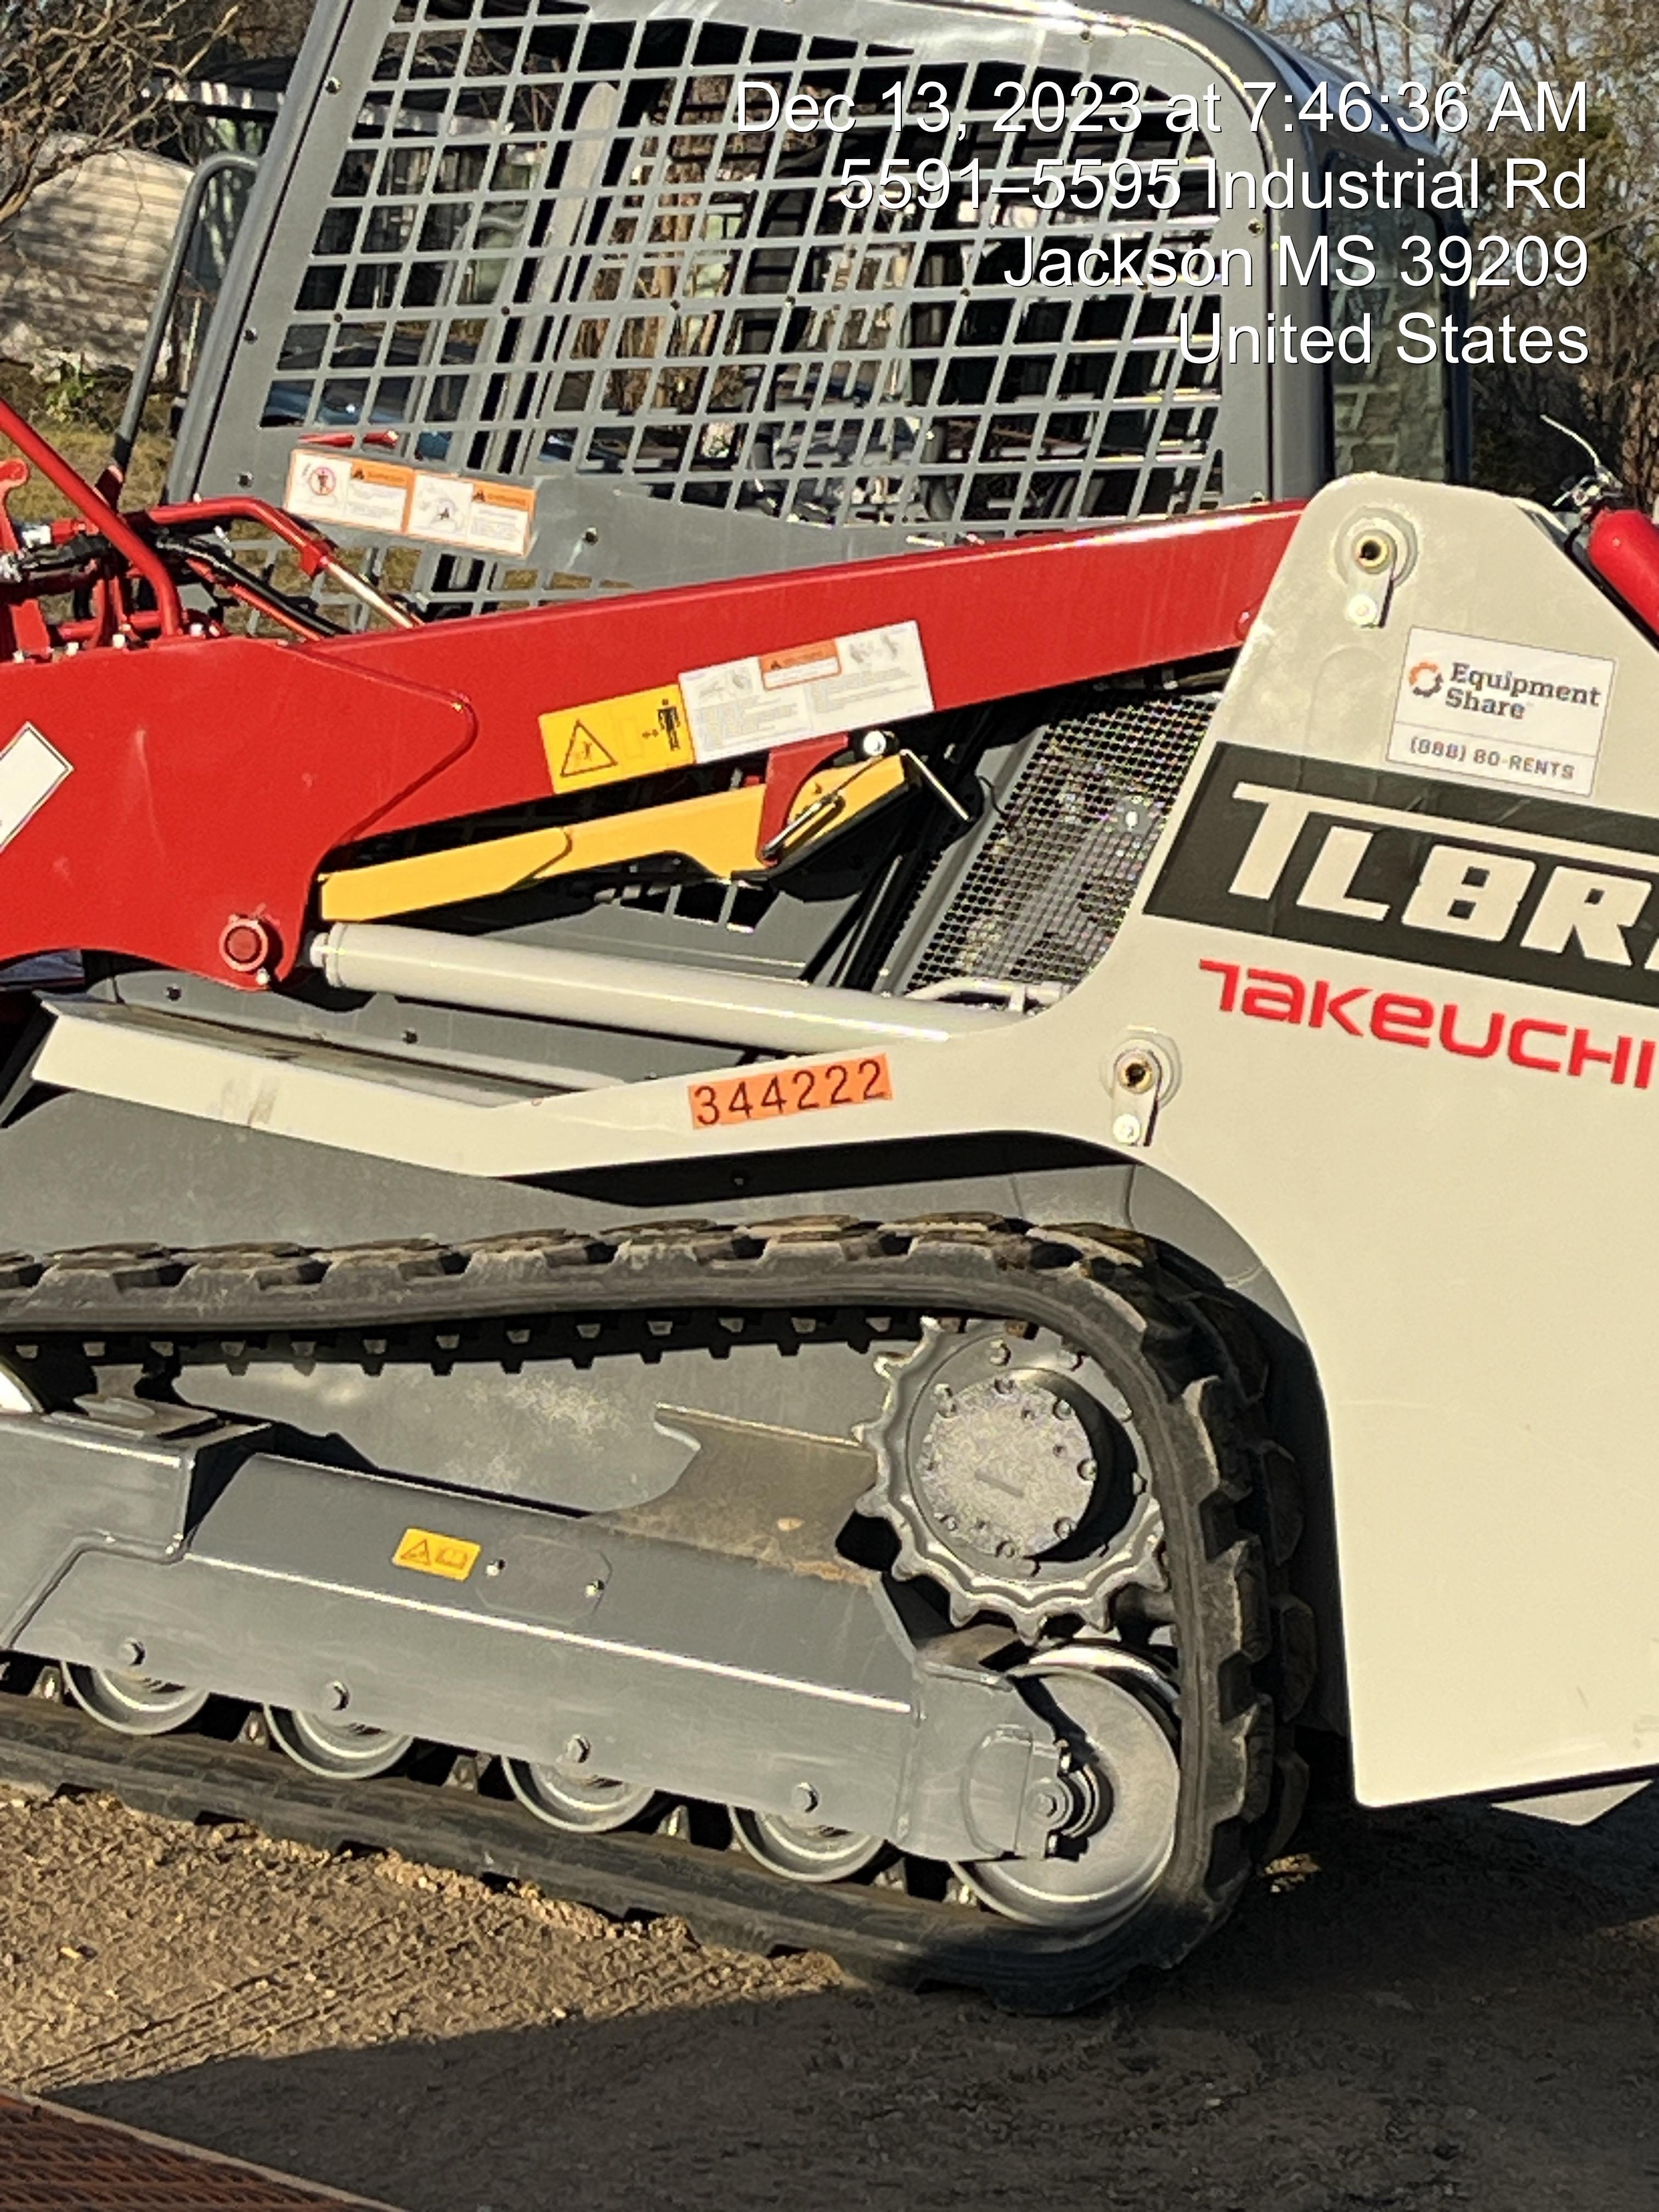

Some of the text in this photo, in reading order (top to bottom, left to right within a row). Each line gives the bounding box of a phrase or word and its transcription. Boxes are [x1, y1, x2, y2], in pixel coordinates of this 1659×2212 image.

[1445, 686, 1526, 720] Share
[1450, 662, 1601, 707] Equipment
[1409, 737, 1576, 780] (888) 80-RENTS
[1228, 782, 1659, 973] TL8R
[694, 1059, 885, 1125] 344222
